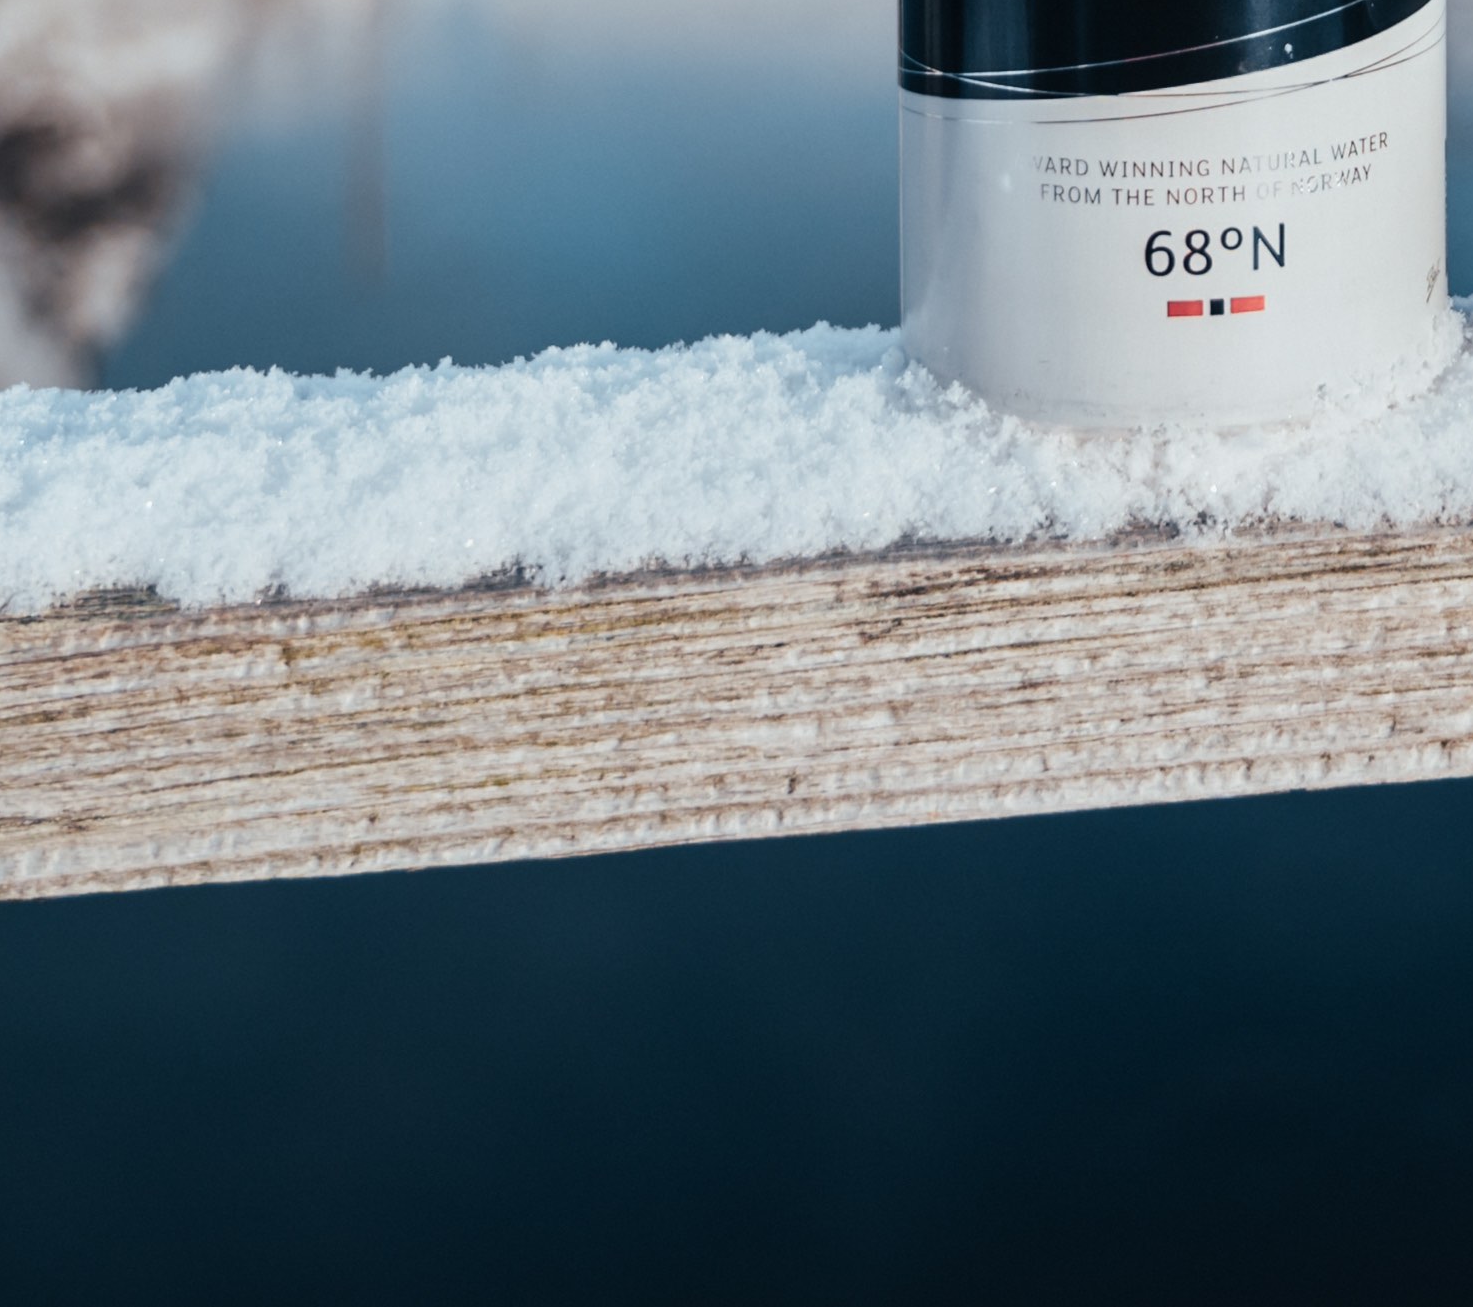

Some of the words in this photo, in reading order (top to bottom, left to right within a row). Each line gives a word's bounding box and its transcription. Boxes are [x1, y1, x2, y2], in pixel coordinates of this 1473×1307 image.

[1029, 156, 1089, 177] WARD
[1099, 159, 1210, 179] WINNING
[1221, 148, 1322, 176] NATURAL
[1331, 131, 1389, 162] WATER
[1040, 183, 1102, 205] FROM
[1111, 188, 1155, 206] THE
[1166, 186, 1246, 206] NORTH
[1257, 180, 1283, 201] OF
[1291, 163, 1372, 196] NORWAY
[1144, 222, 1286, 277] 68°N
